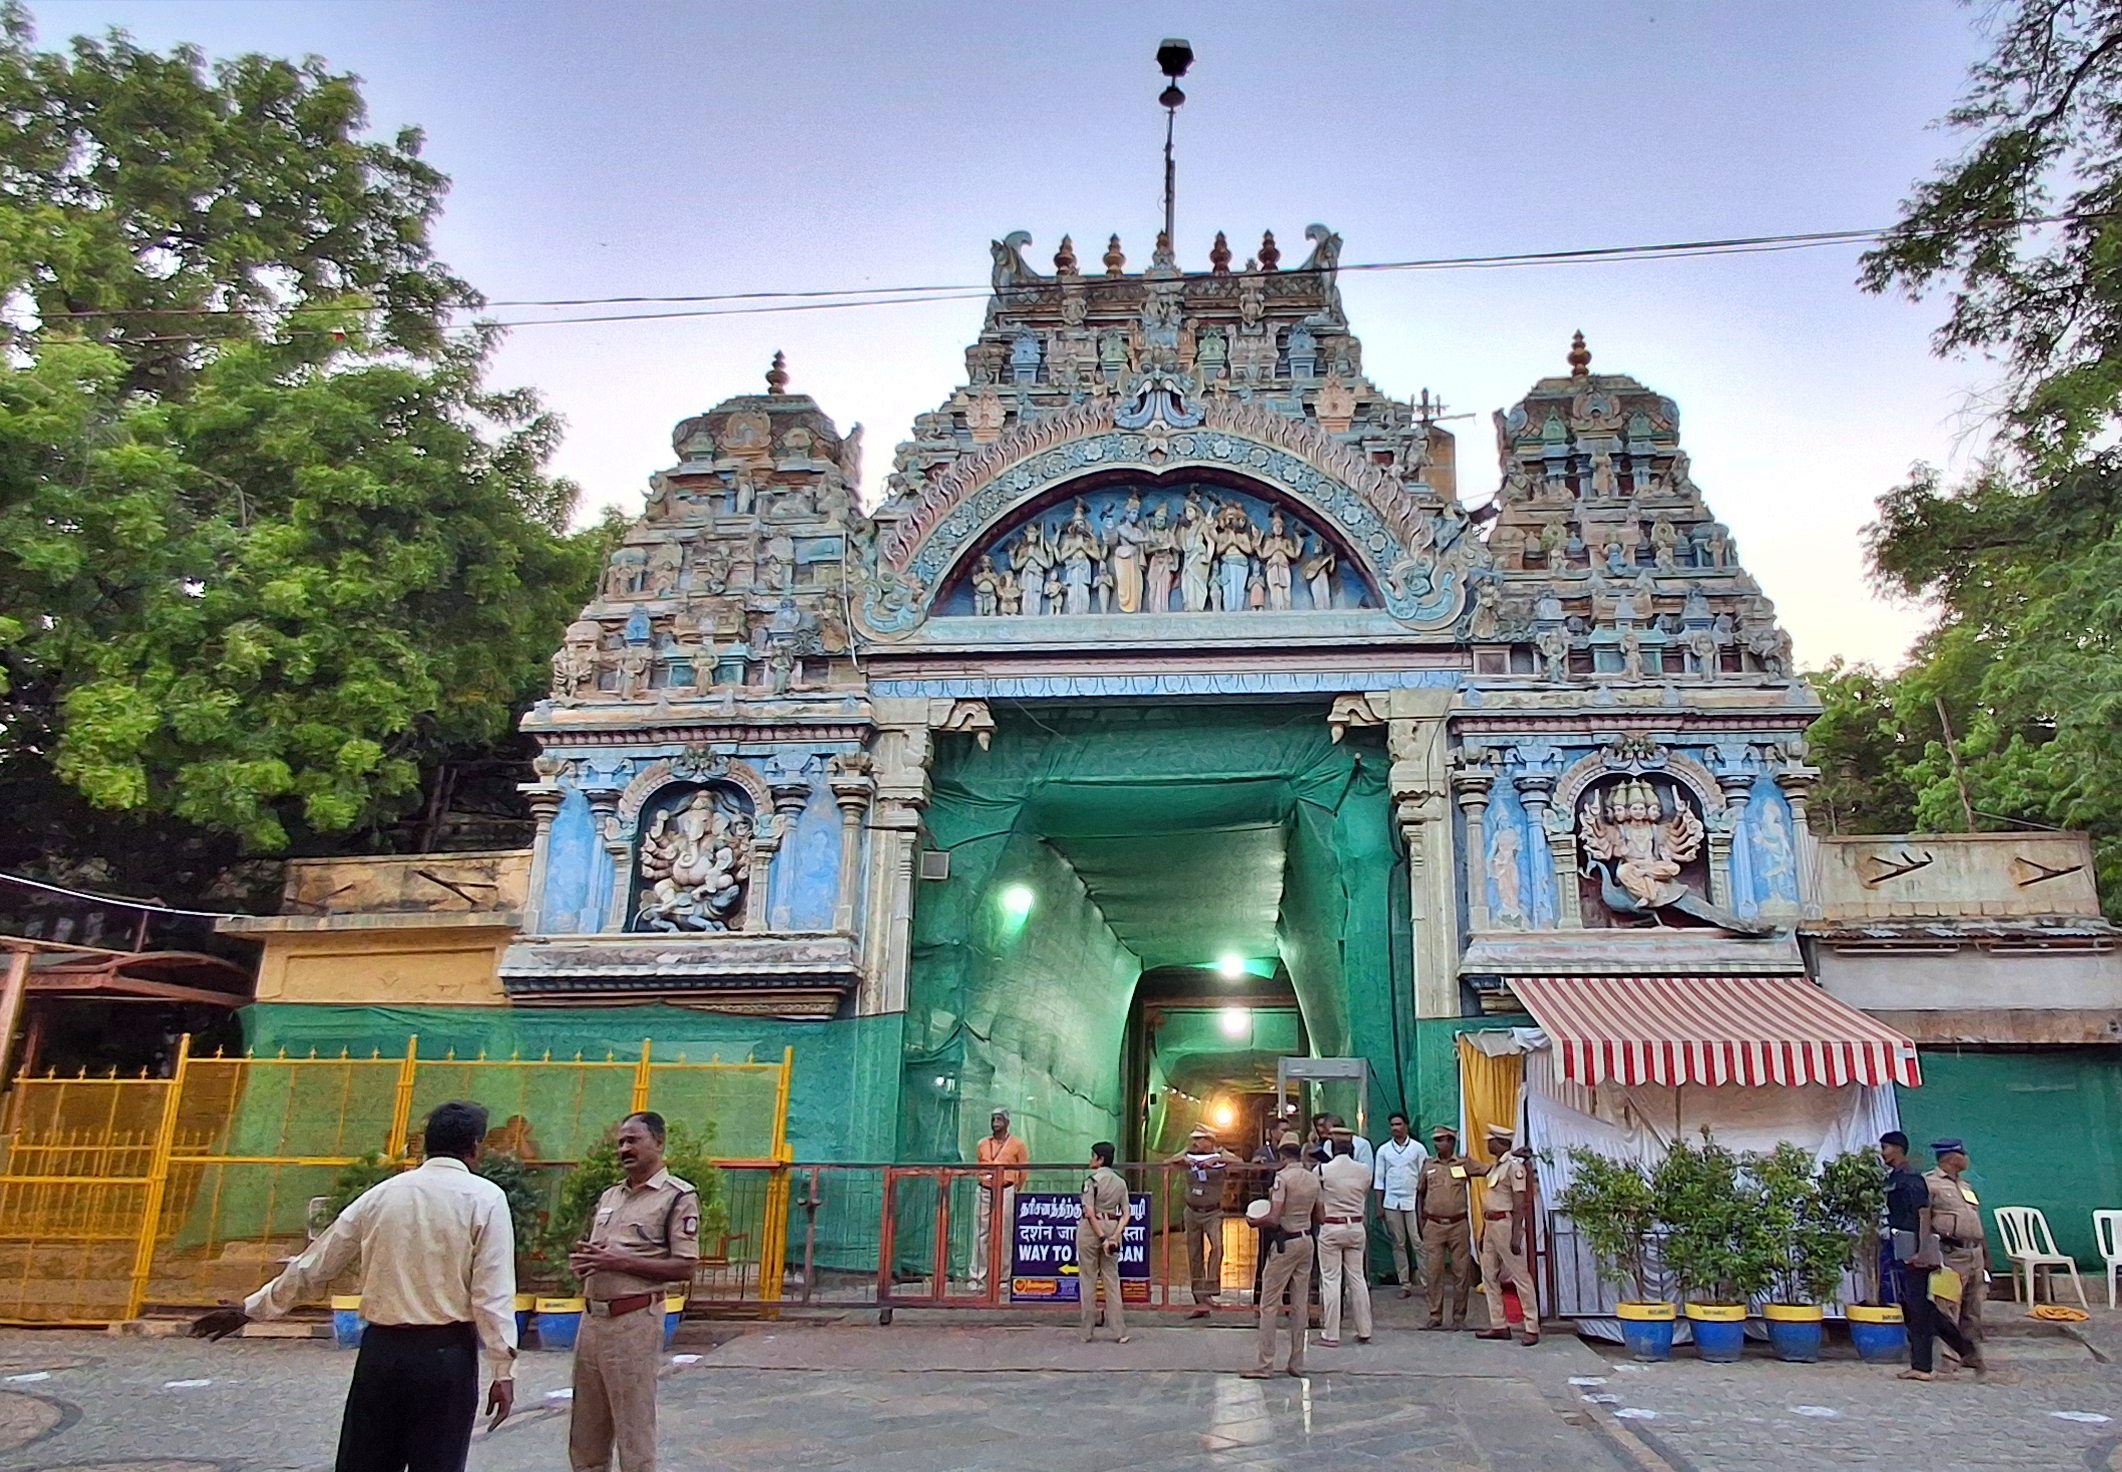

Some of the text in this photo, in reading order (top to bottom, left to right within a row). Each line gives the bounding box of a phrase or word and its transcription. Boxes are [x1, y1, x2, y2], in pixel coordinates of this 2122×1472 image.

[1018, 1219, 1146, 1242] दर्शन जा स्ता
[1018, 1244, 1050, 1262] WAY
[1052, 1244, 1072, 1262] TO
